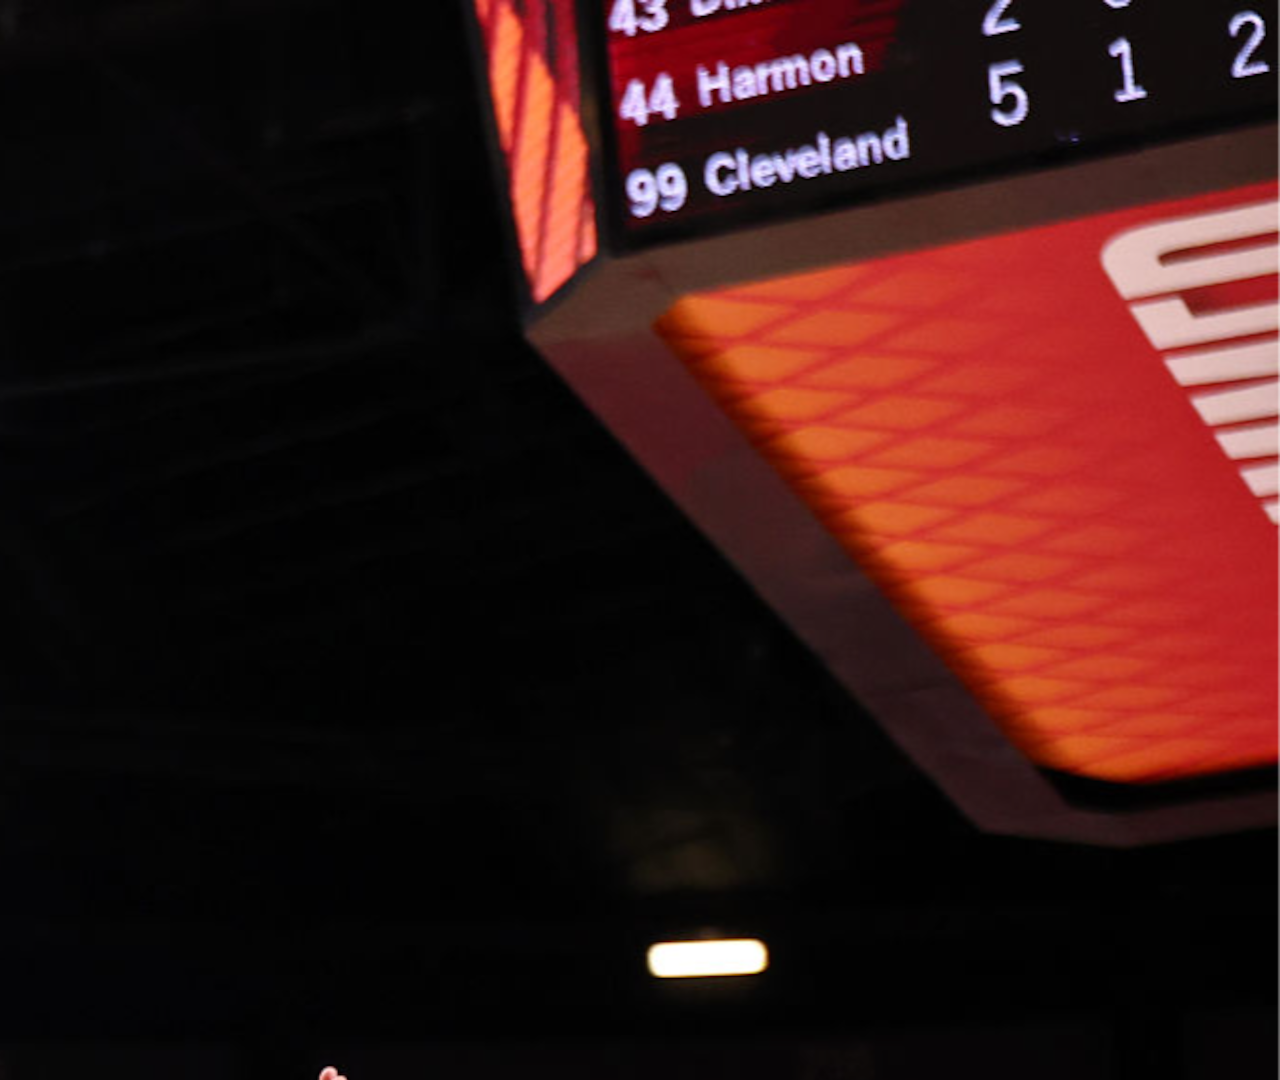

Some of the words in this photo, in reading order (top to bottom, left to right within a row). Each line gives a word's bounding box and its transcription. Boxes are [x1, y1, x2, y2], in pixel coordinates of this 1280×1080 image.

[619, 72, 680, 127] 44
[696, 42, 865, 108] Harmon
[625, 161, 689, 218] 99
[703, 114, 910, 197] Cleveland
[989, 59, 1029, 127] 5
[1108, 36, 1148, 102] 1
[1228, 9, 1270, 78] 2
